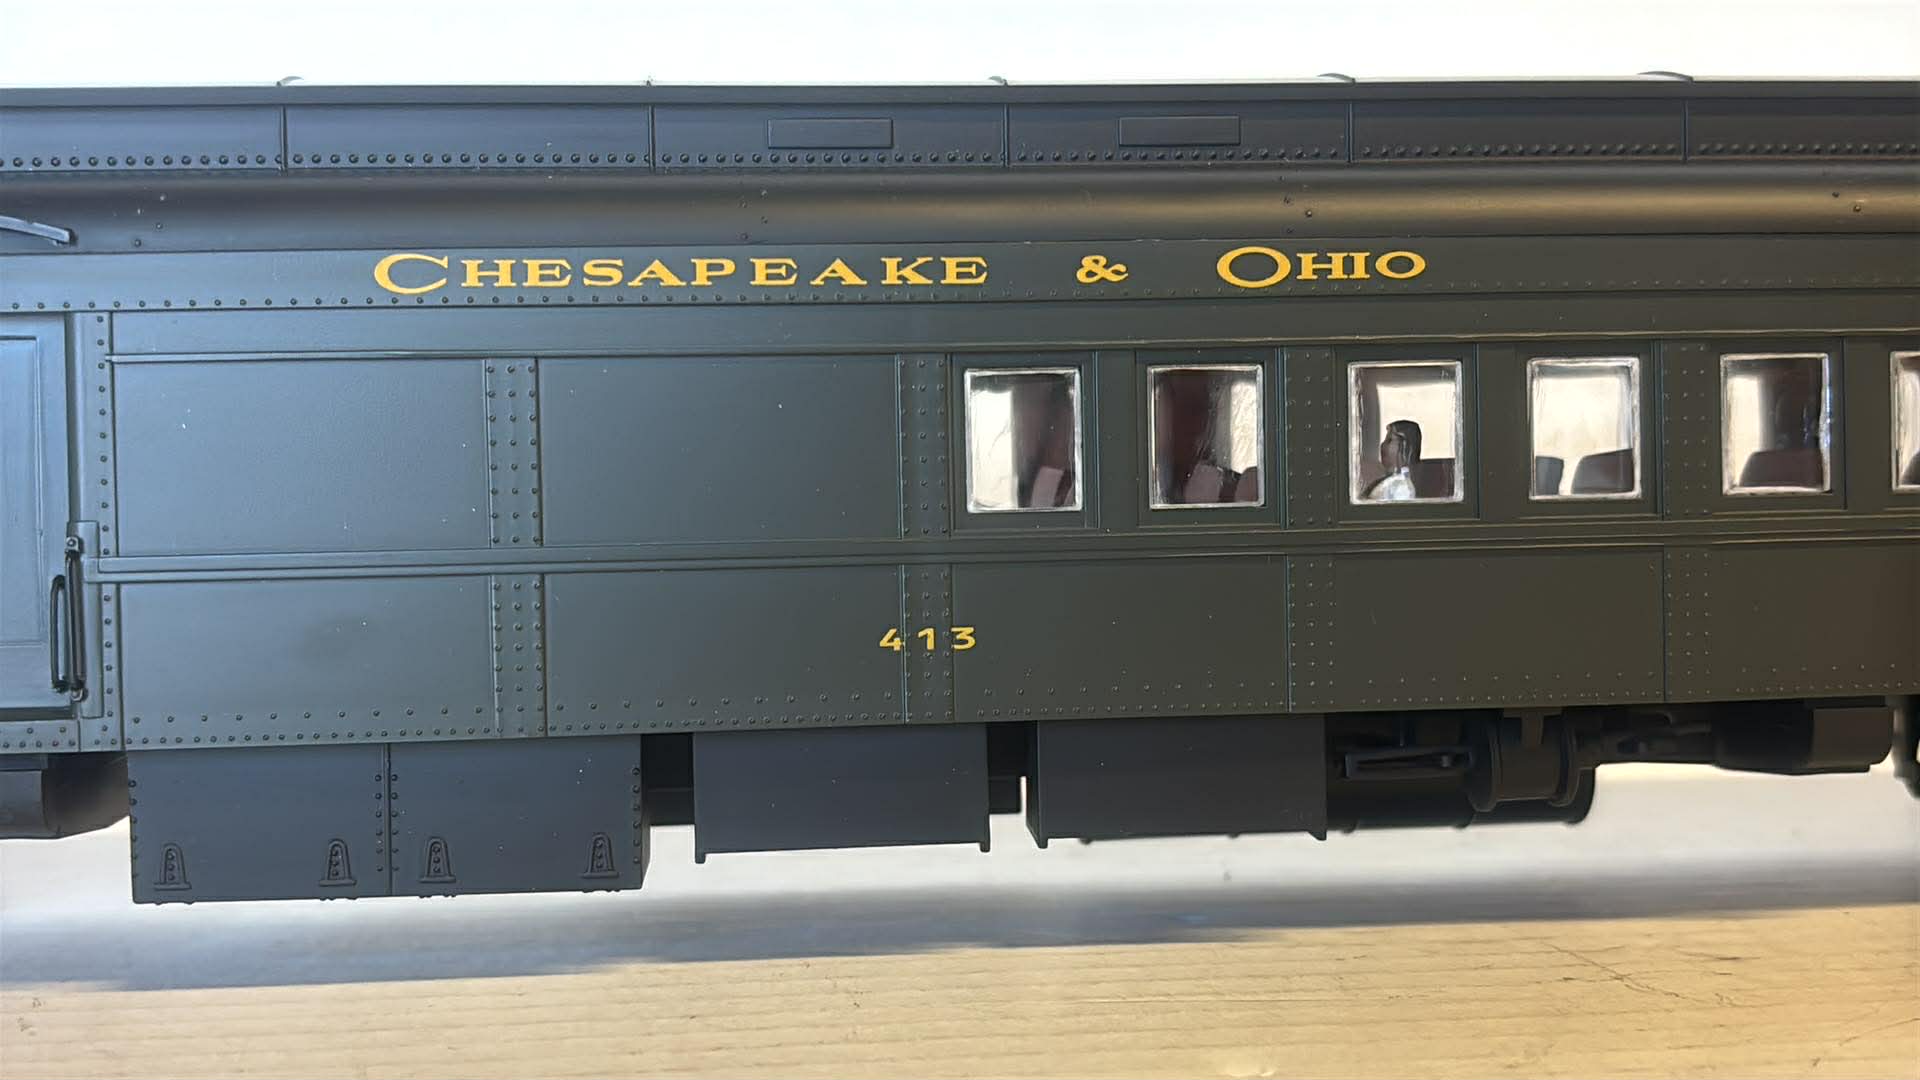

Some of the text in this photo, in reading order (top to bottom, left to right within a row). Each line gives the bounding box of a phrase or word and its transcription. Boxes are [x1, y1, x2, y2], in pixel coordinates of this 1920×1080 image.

[372, 245, 1428, 296] CHESAPEAKE & OHIO
[878, 626, 977, 651] 413
